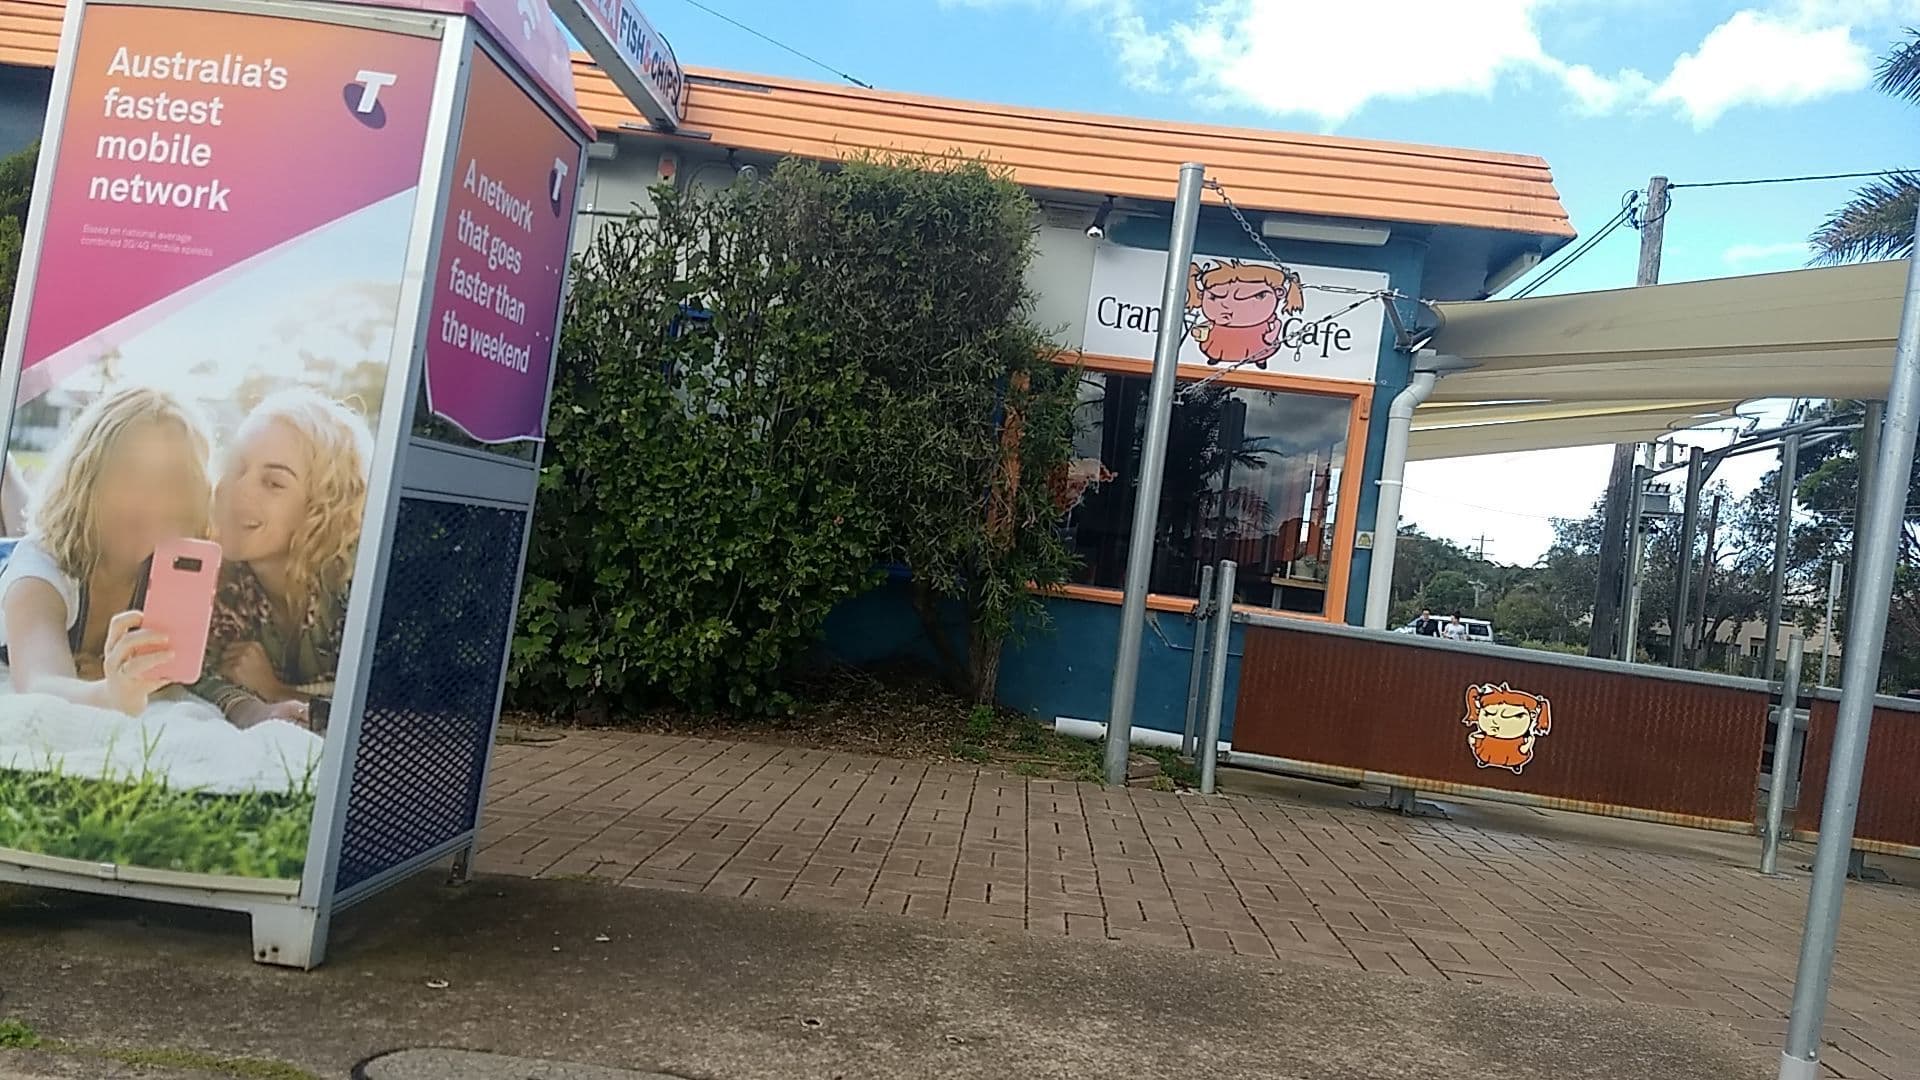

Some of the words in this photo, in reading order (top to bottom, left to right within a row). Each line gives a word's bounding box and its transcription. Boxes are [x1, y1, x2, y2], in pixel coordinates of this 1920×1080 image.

[106, 46, 289, 90] Australia's
[619, 7, 644, 65] FISH
[643, 40, 652, 73] &
[651, 51, 678, 106] CHIPS
[103, 87, 224, 126] fastest
[96, 132, 212, 167] mobile
[88, 174, 231, 212] network
[463, 158, 477, 194] A
[477, 173, 533, 233] network
[458, 208, 490, 255] that
[488, 236, 522, 275] goes
[449, 257, 495, 309] faster
[495, 284, 526, 326] than
[442, 310, 468, 349] the
[469, 327, 531, 374] weekend
[1282, 316, 1352, 358] Cafe
